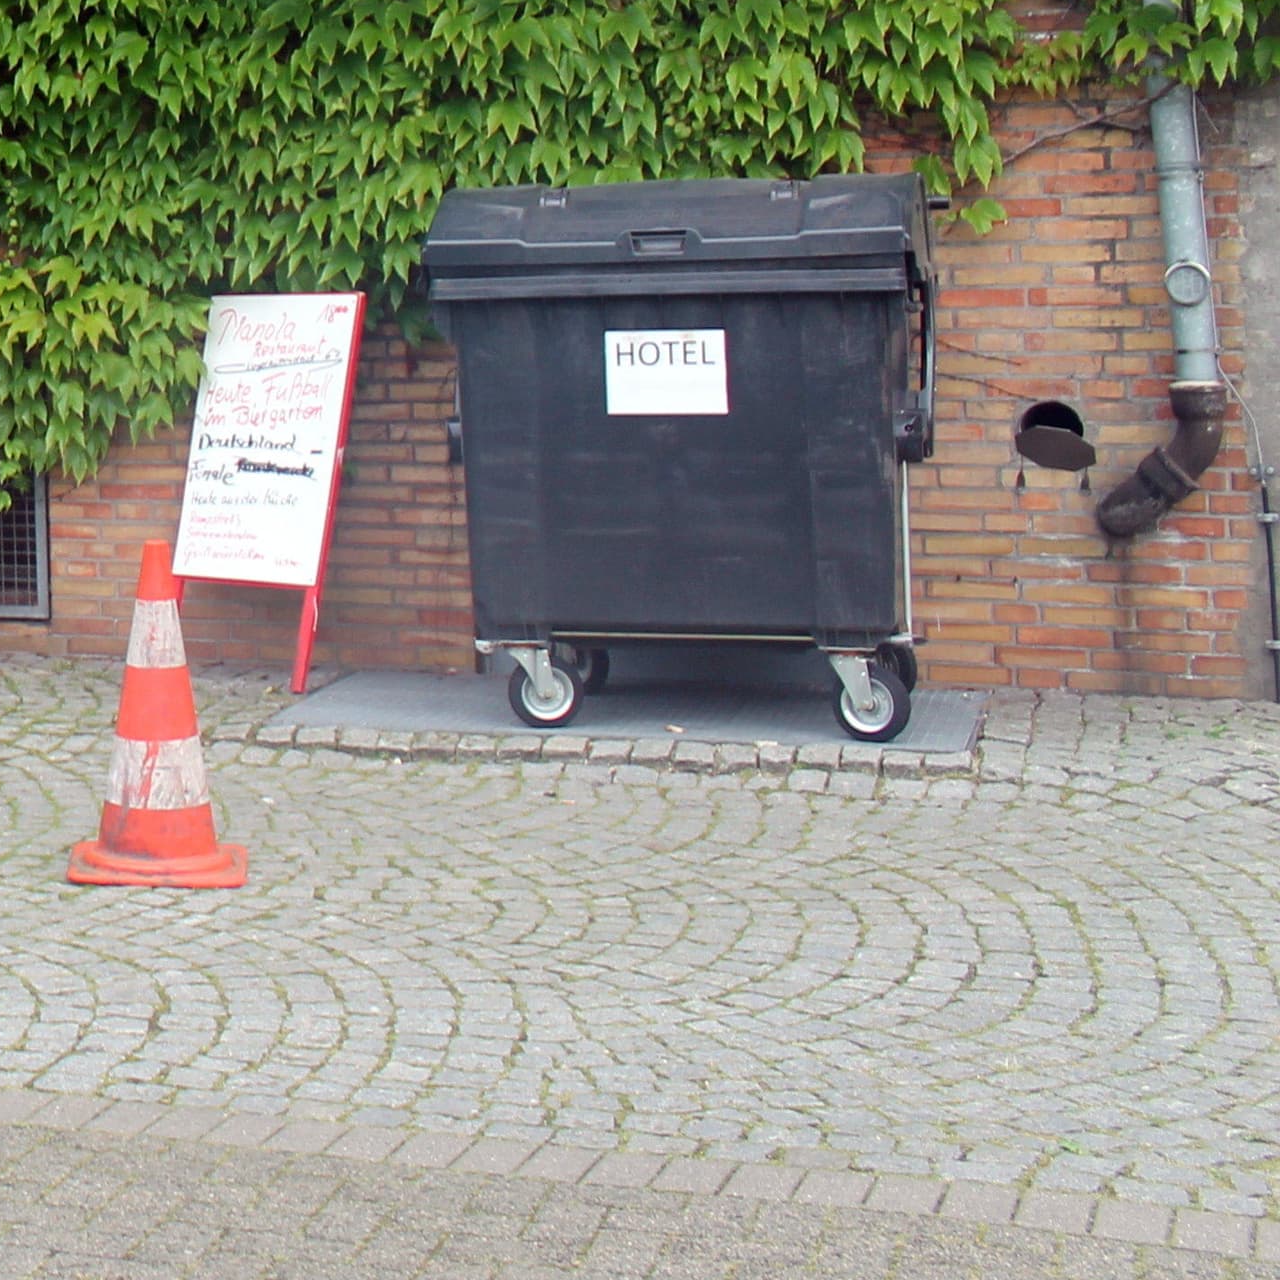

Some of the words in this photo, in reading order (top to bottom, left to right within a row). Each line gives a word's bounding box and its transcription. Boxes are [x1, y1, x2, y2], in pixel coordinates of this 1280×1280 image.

[616, 340, 715, 366] HOTEL
[204, 380, 252, 406] Heute
[261, 371, 334, 406] Fußball
[203, 406, 226, 427] im
[231, 402, 323, 430] Biergarten
[198, 433, 297, 451] Deutschland
